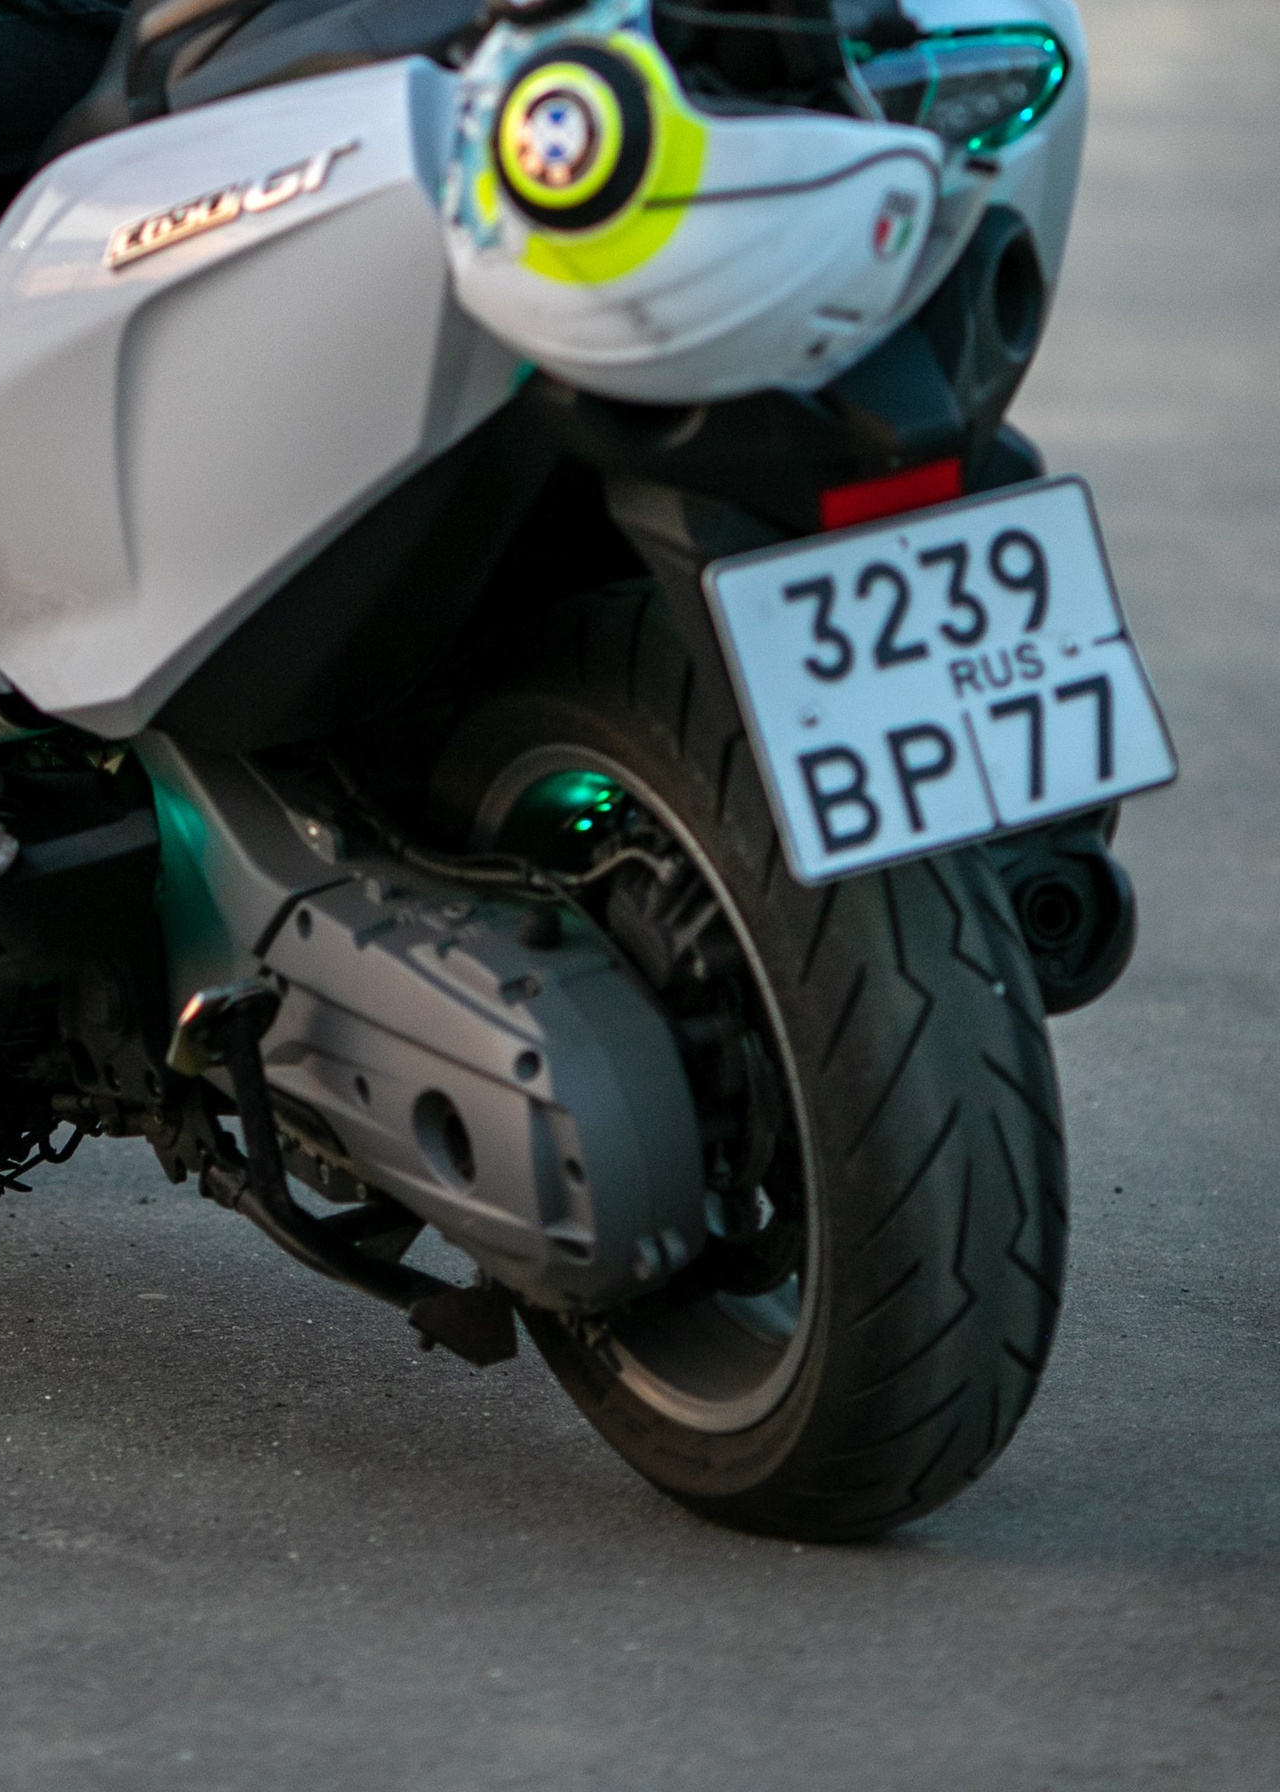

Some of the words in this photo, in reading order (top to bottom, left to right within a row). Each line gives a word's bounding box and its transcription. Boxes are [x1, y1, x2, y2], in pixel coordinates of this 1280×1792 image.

[782, 527, 1050, 683] 3239
[947, 642, 1046, 699] RUS
[989, 673, 1114, 802] 77
